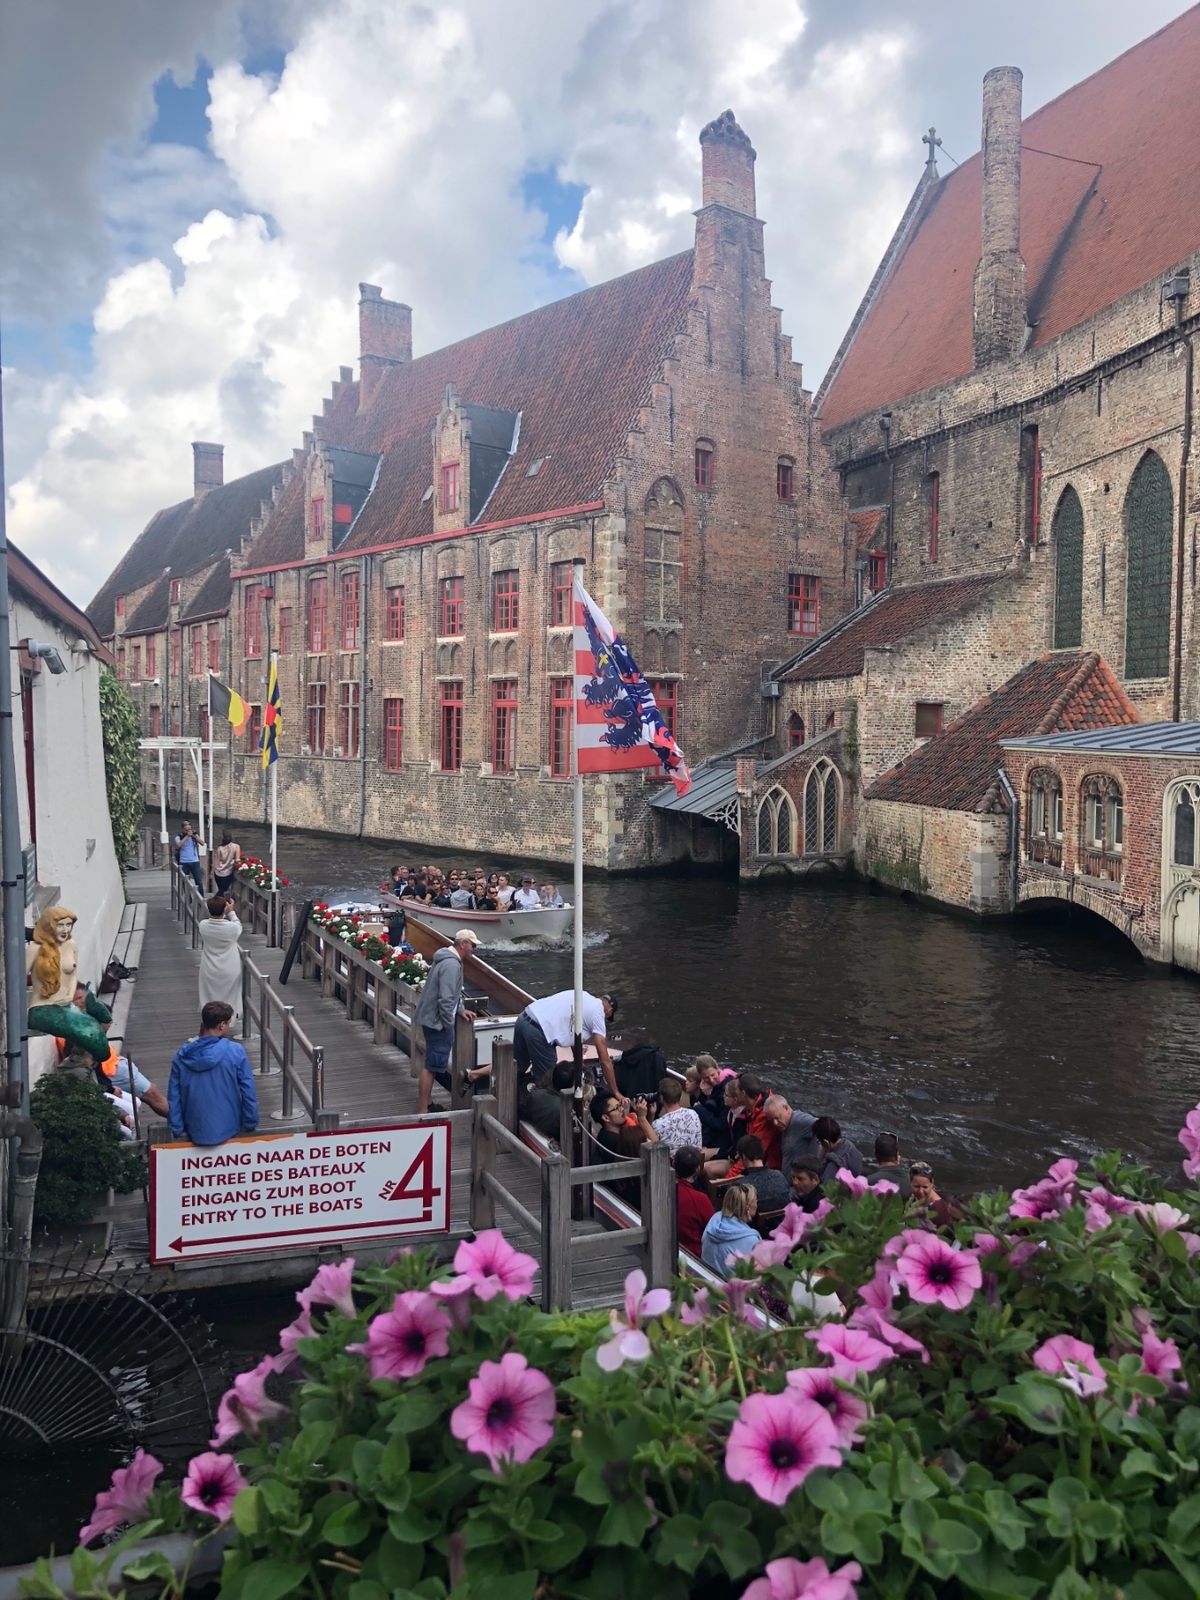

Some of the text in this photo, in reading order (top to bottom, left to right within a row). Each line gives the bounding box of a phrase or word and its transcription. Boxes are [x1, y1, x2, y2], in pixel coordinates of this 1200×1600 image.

[181, 1141, 392, 1170] INGANG NAAR DE BOTEN
[378, 1131, 441, 1208] NR 4
[181, 1161, 366, 1189] ENTREE DES BATEAUX
[181, 1180, 357, 1208] EINGANG ZUM BOOT
[181, 1197, 363, 1226] ENTRY TO THE BOATS
